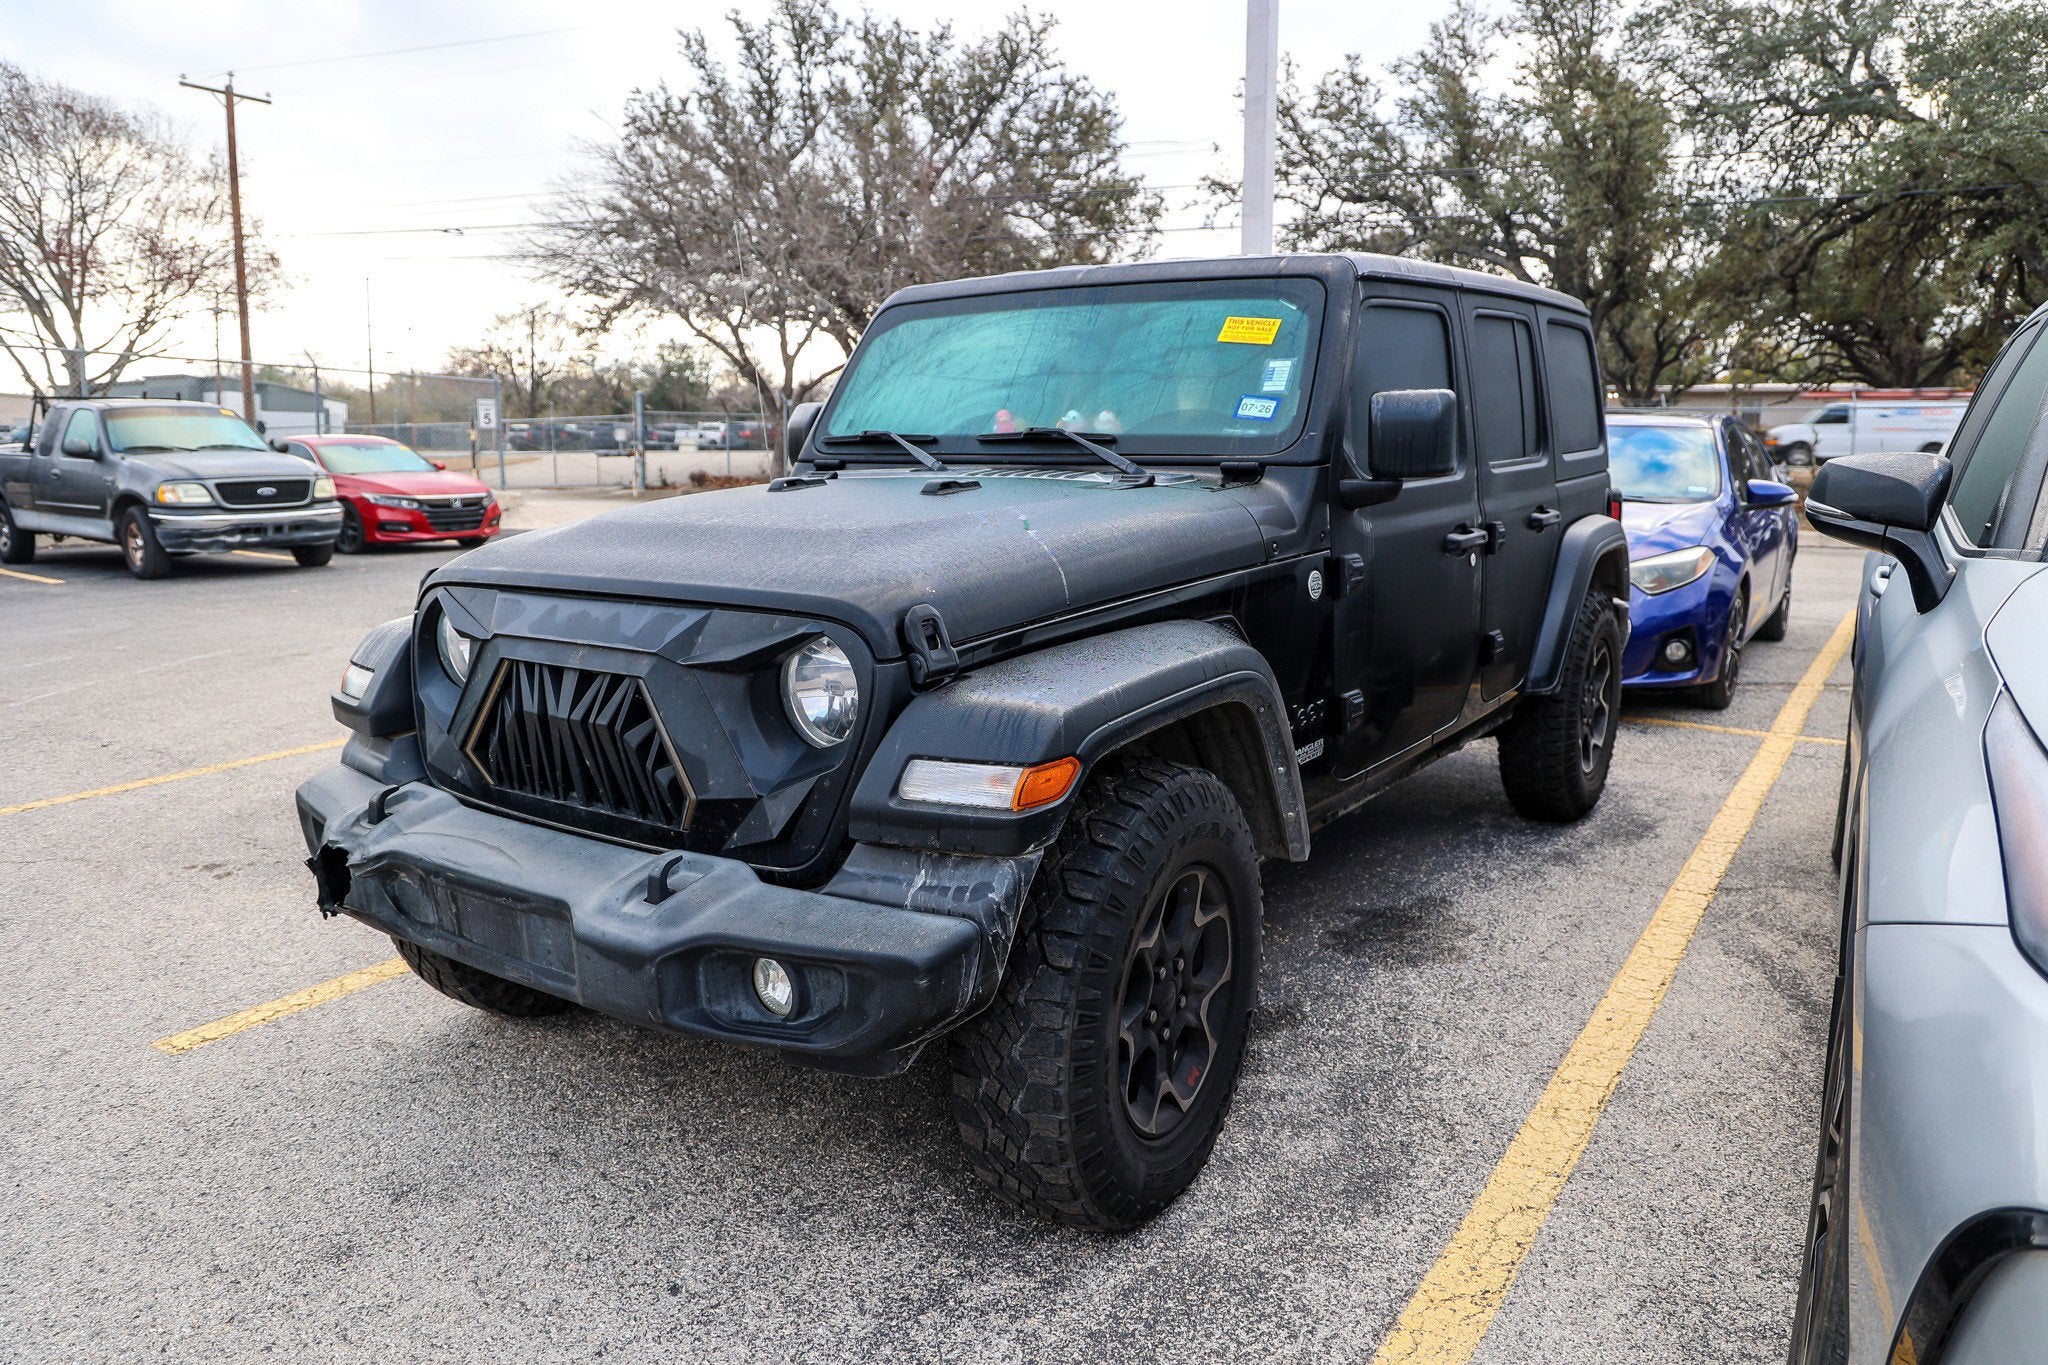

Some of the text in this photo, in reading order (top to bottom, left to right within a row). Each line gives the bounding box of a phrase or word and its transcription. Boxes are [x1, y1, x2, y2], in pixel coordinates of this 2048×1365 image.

[1246, 319, 1278, 327] VEHICLE
[483, 413, 491, 424] 5
[1294, 738, 1324, 757] ANGLER
